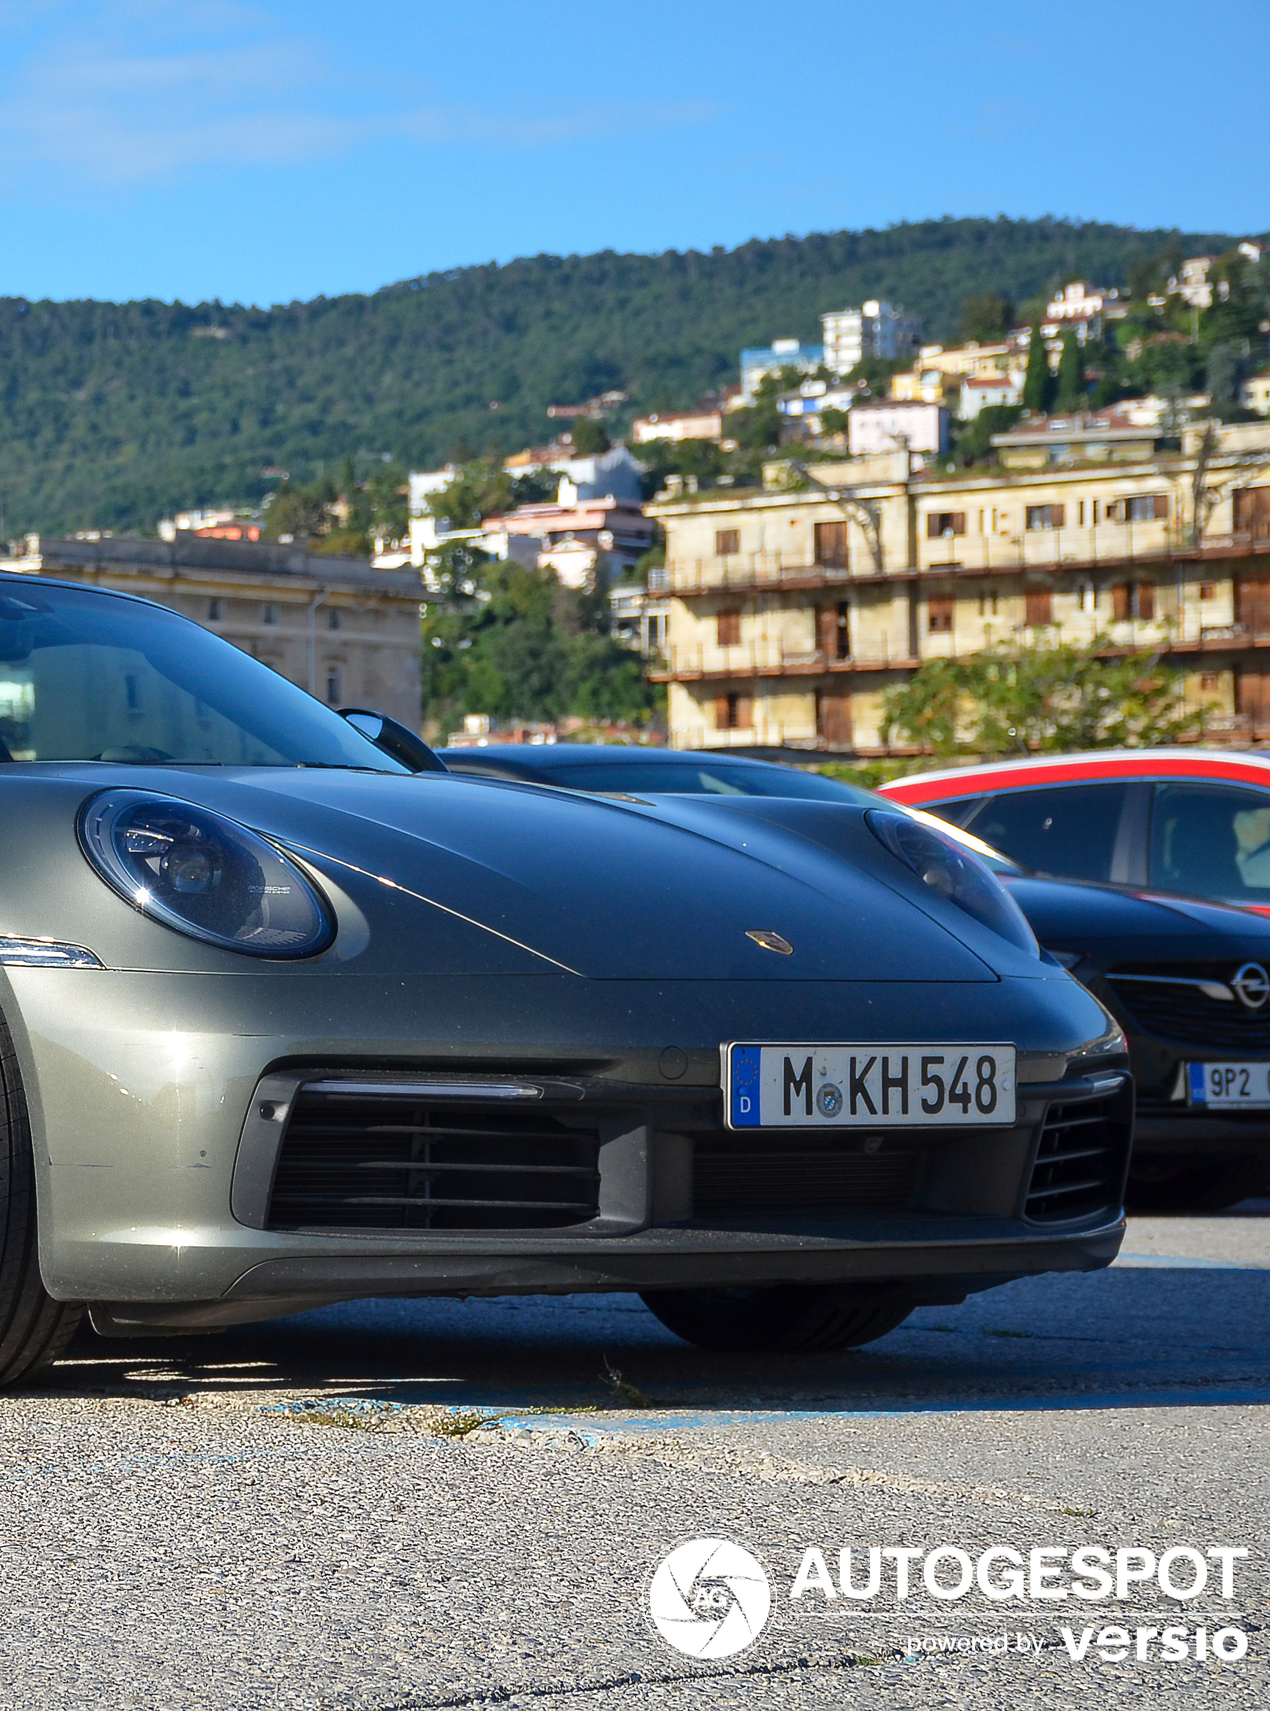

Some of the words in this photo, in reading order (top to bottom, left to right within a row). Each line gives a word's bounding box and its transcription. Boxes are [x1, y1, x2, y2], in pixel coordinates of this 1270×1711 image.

[783, 1056, 813, 1116] M
[849, 1056, 909, 1115] KH
[920, 1055, 997, 1114] 548
[1211, 1068, 1250, 1097] 9P2
[740, 1096, 751, 1113] D
